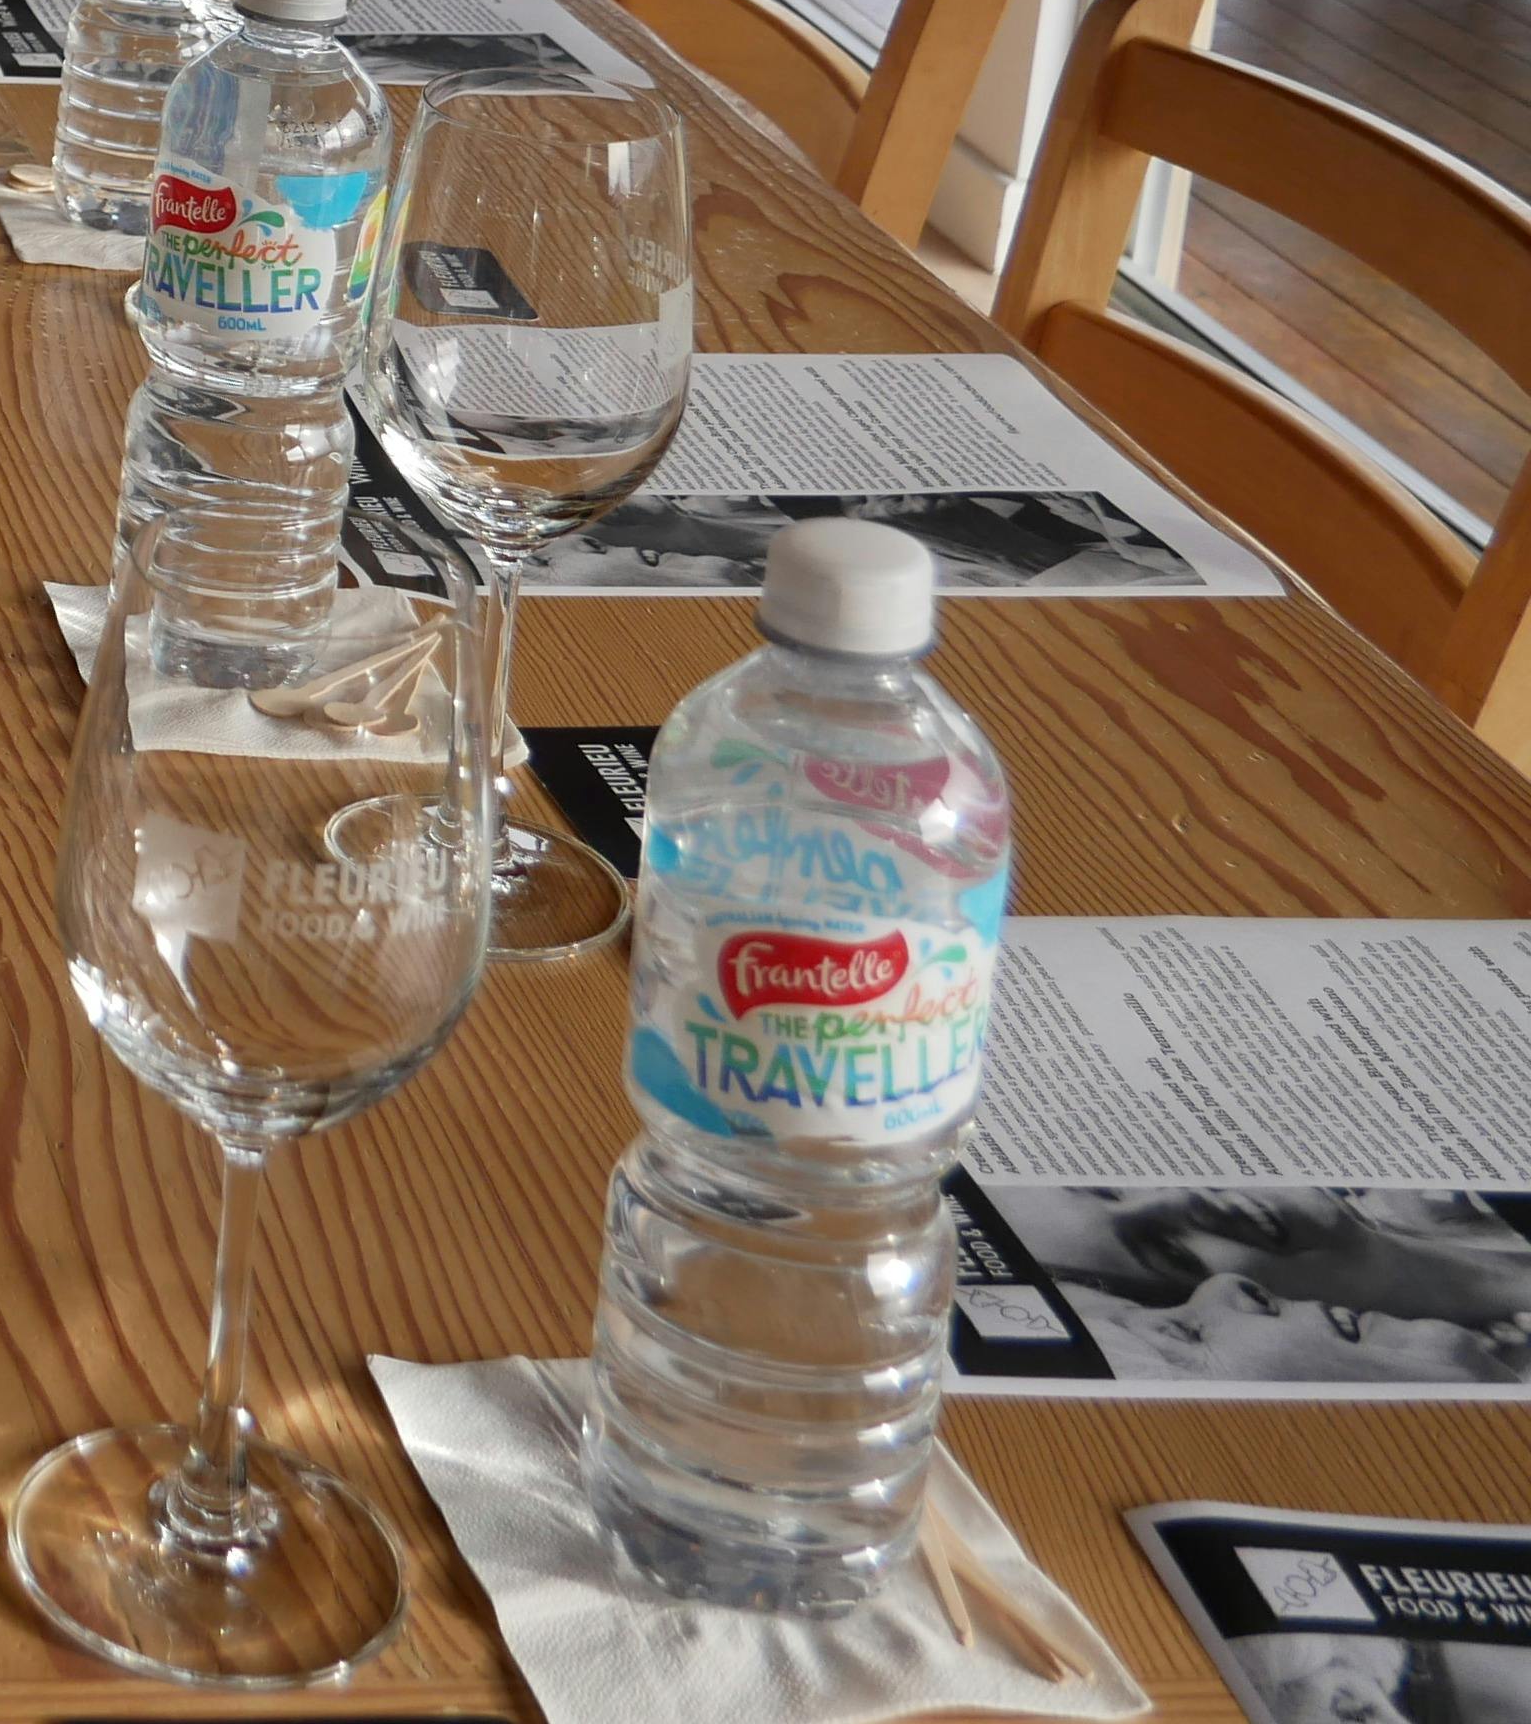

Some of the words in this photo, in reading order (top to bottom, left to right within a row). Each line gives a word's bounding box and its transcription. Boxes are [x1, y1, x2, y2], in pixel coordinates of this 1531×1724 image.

[162, 231, 181, 252] THE
[183, 229, 303, 270] perfect
[146, 244, 322, 313] RAVELLER
[614, 743, 649, 768] WINE
[761, 1012, 808, 1039] THE
[813, 973, 977, 1055] perfect
[970, 1241, 1014, 1277] FOOD
[1381, 1595, 1459, 1619] FOOD
[1464, 1600, 1487, 1621] &
